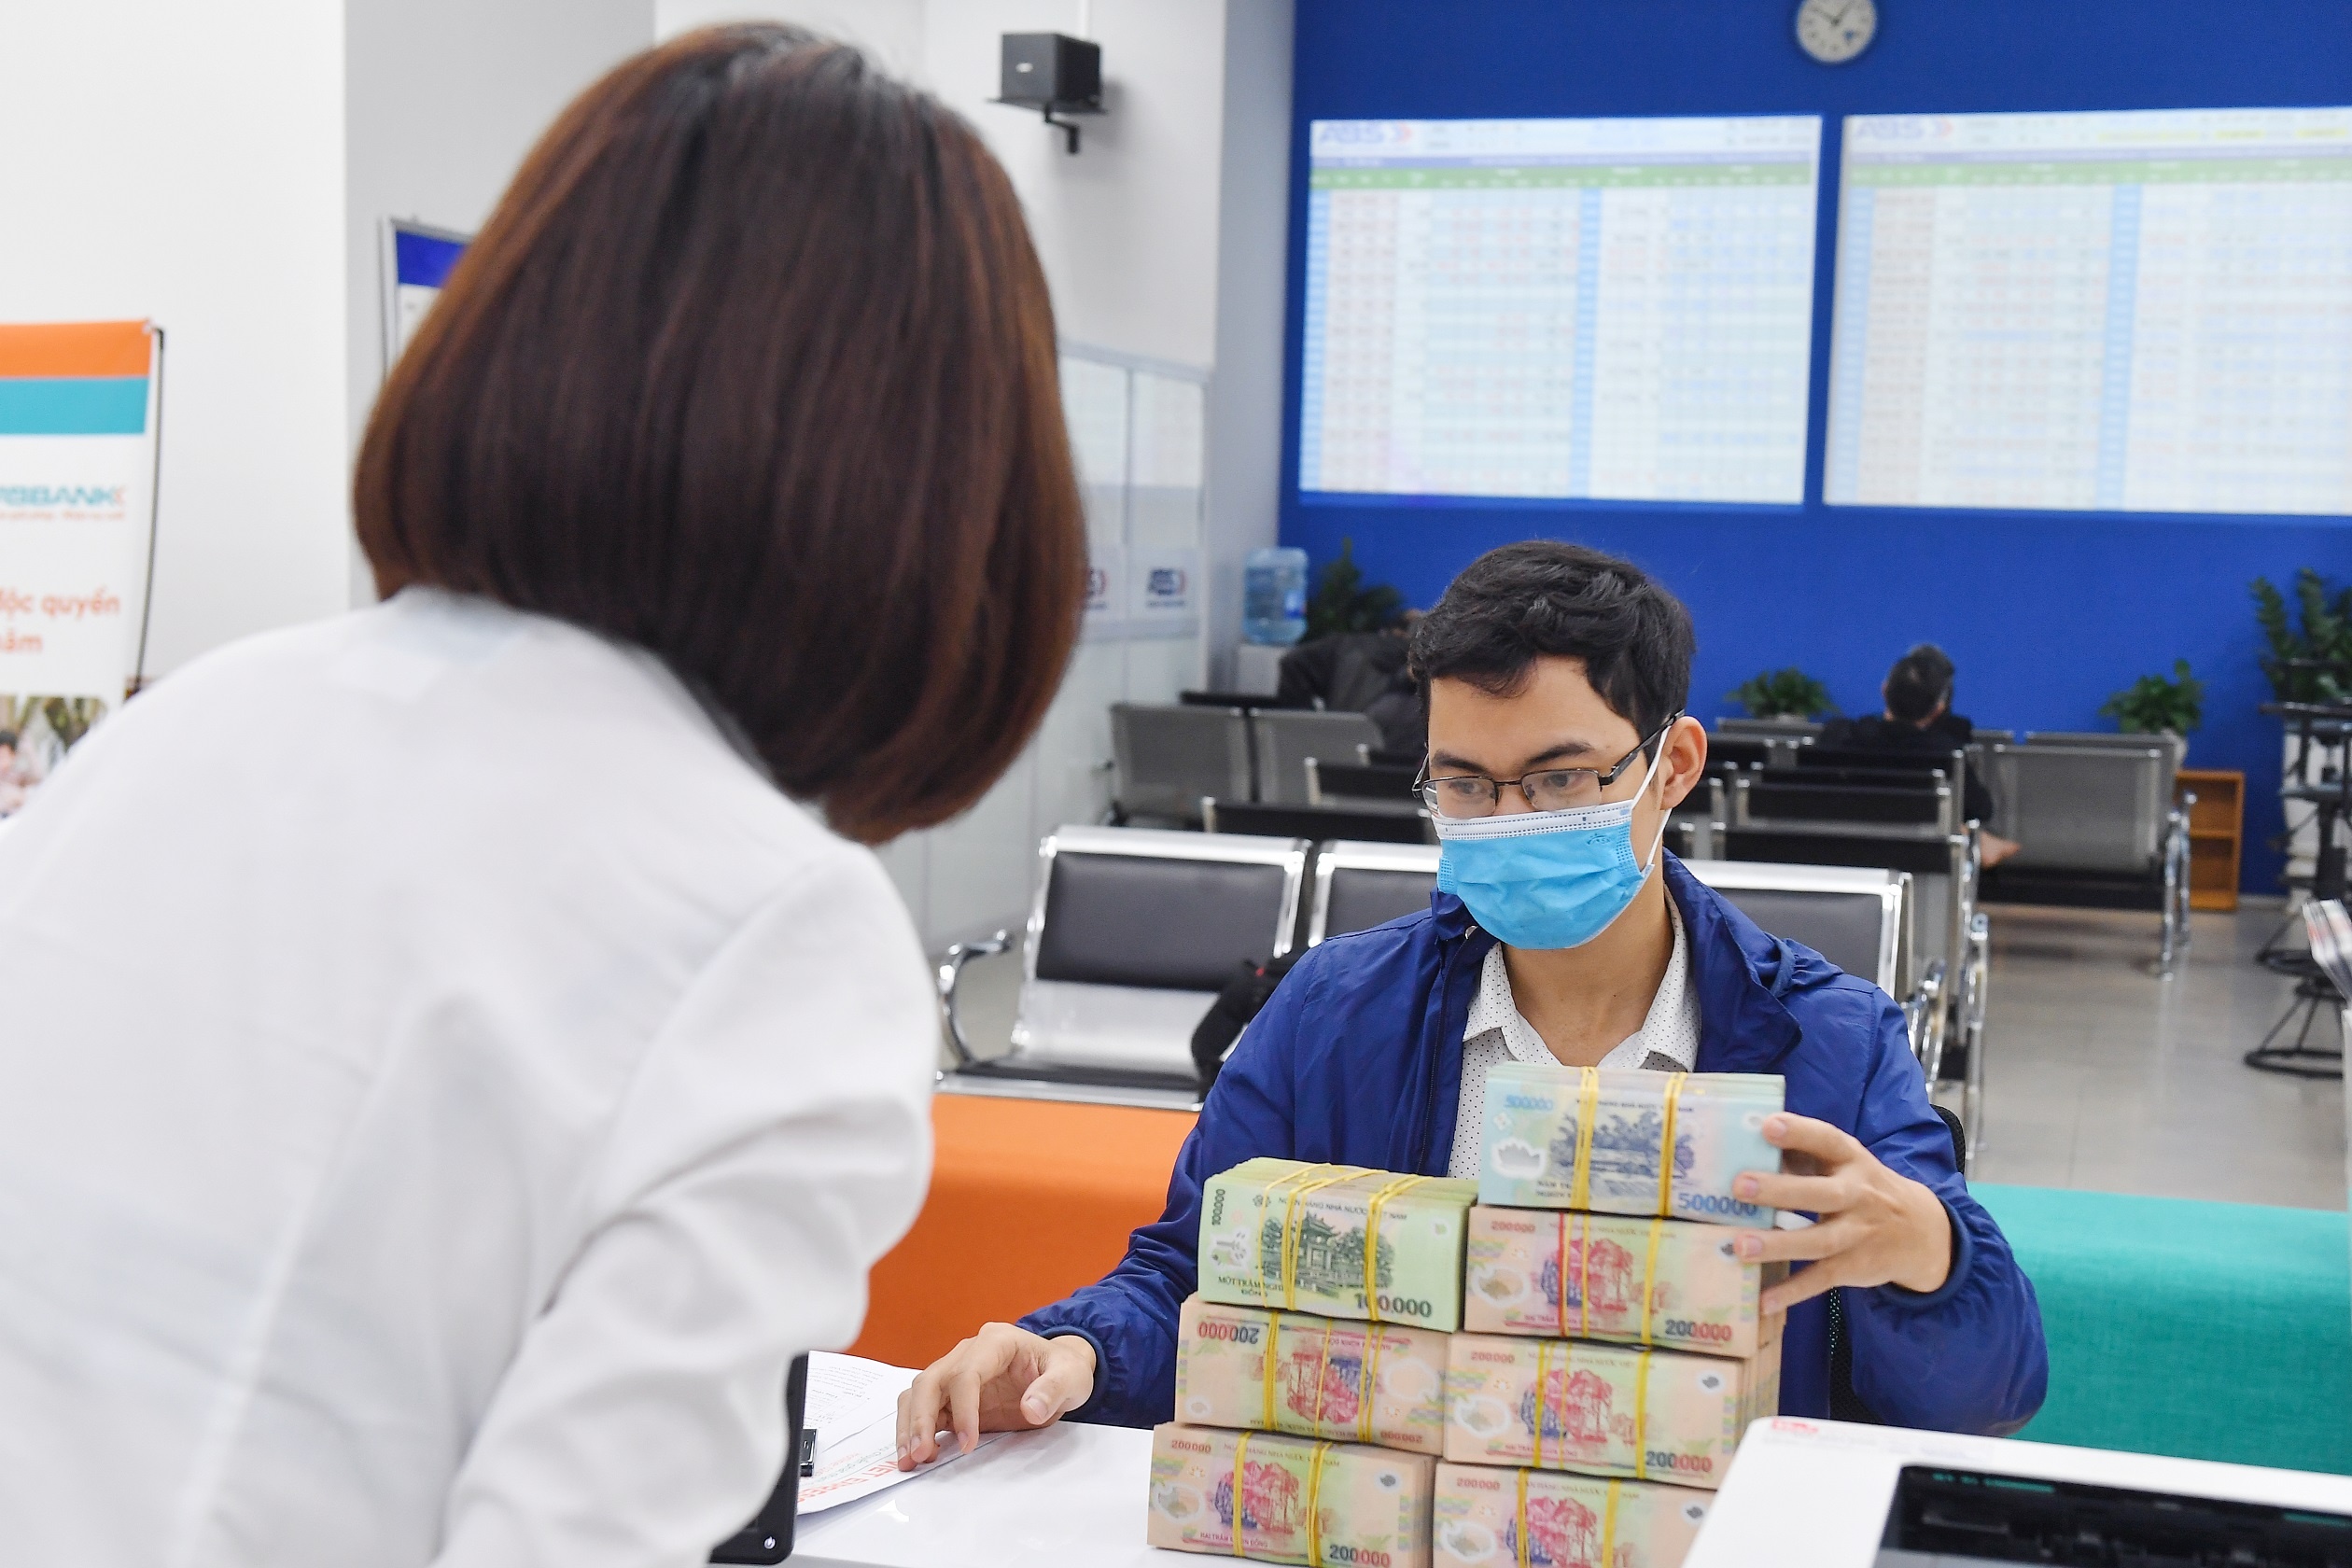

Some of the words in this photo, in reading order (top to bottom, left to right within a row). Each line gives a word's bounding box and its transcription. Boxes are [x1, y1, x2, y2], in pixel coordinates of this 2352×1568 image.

[1678, 1194, 1758, 1216] 500000
[1199, 1322, 1259, 1344] 200000
[1665, 1319, 1732, 1342] 200000
[1171, 1439, 1211, 1453] 200000
[1645, 1450, 1712, 1473] 200000
[1457, 1477, 1500, 1491] 200000
[1329, 1545, 1391, 1566] 200000
